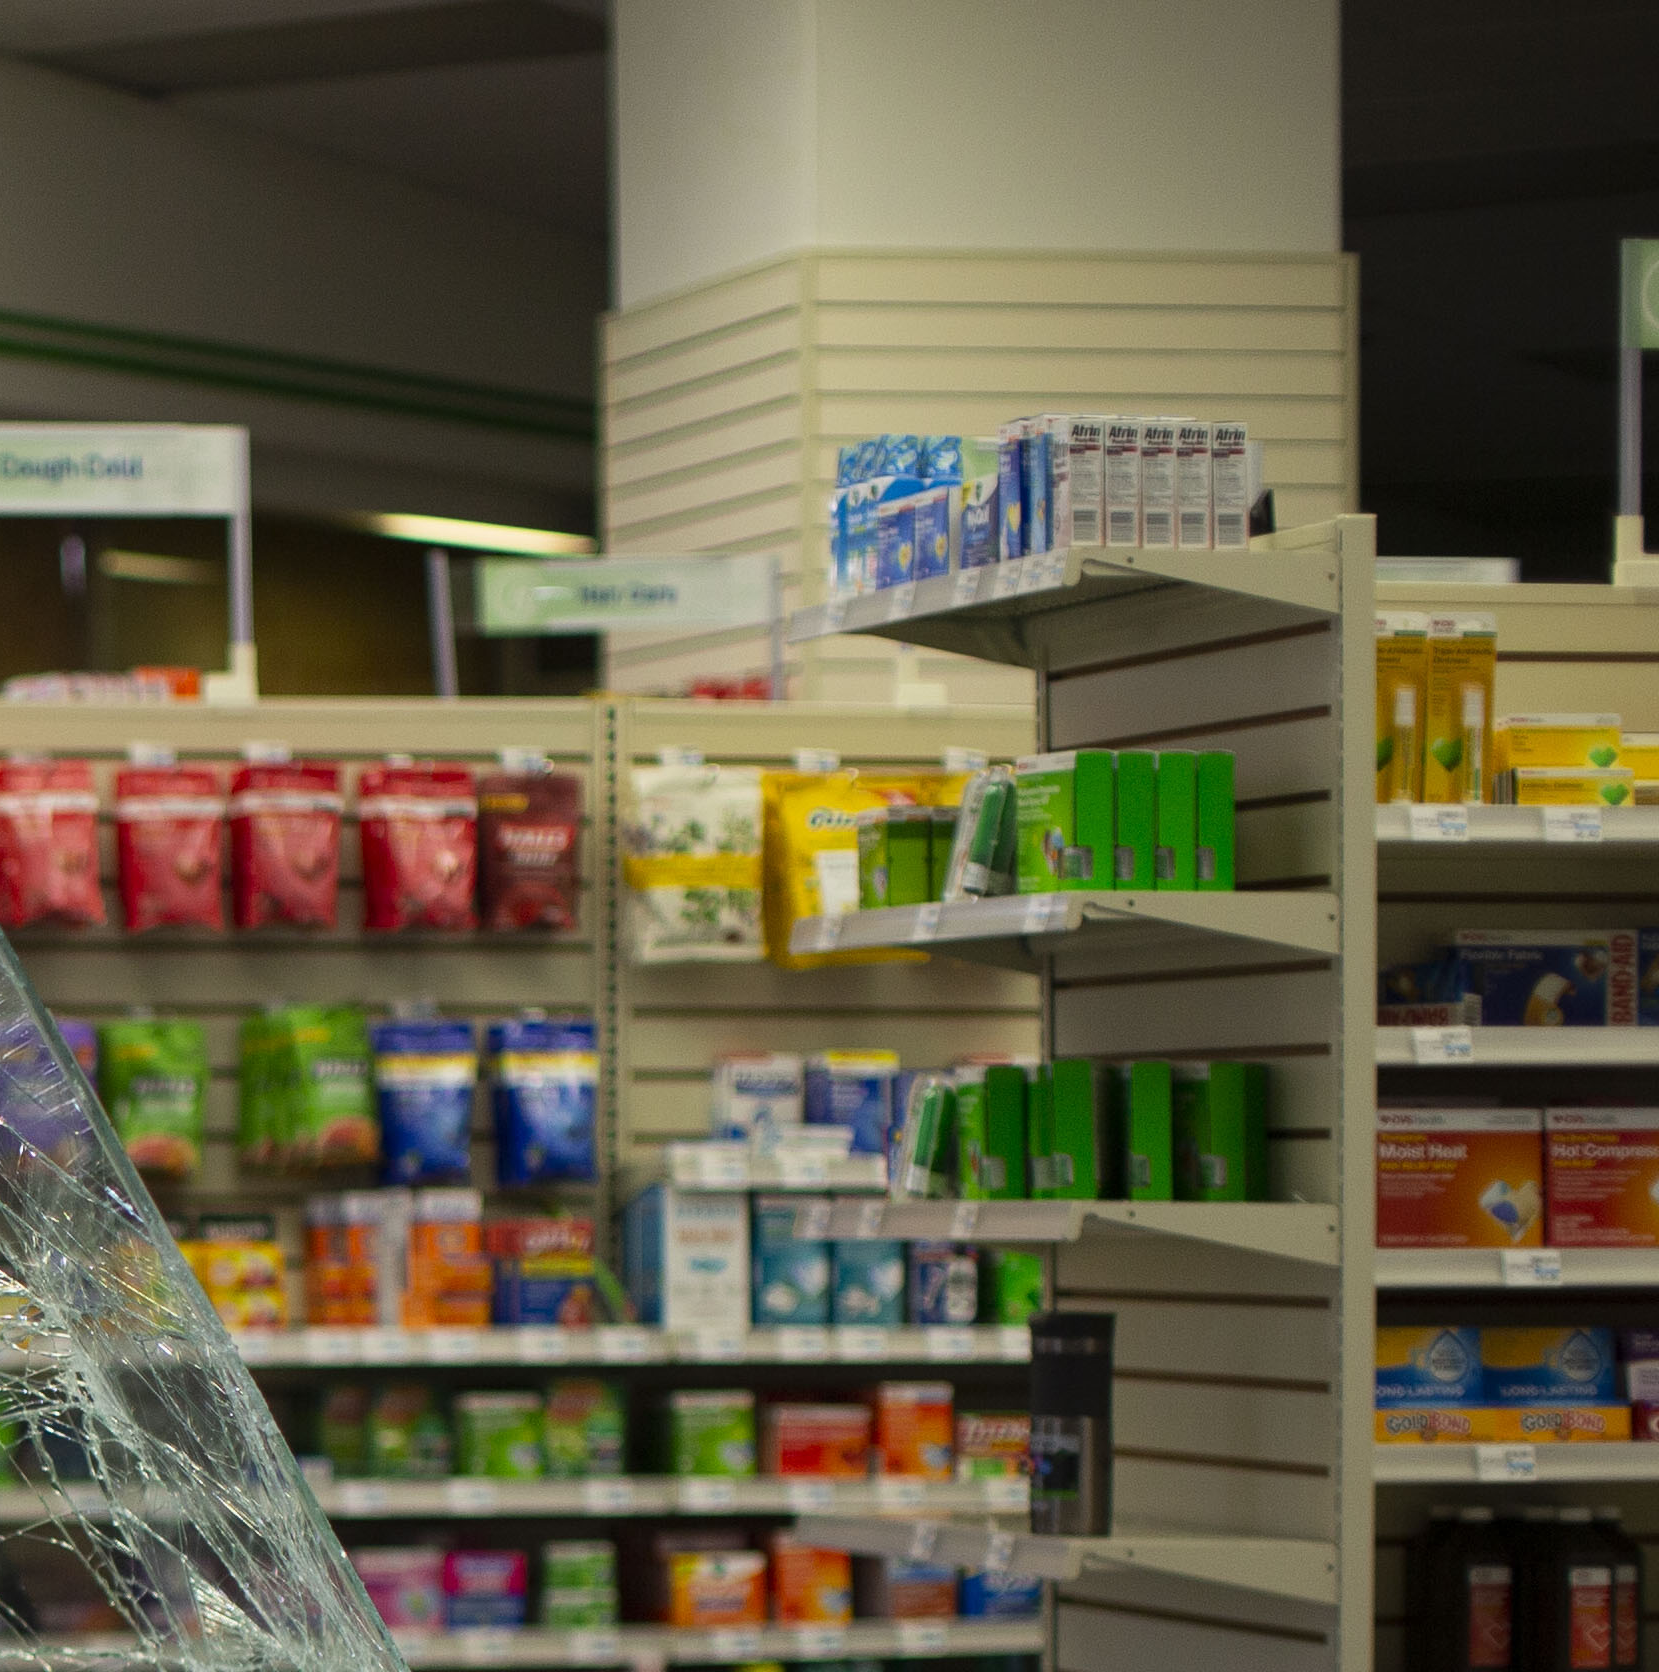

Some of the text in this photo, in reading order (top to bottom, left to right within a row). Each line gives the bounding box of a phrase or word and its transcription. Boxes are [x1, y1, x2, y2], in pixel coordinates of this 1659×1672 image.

[1071, 425, 1101, 437] Afrin
[1109, 426, 1138, 439] Afrin
[1145, 427, 1174, 440] Afrin
[1179, 427, 1209, 440] Afrin
[1215, 428, 1246, 441] Afrin
[1379, 1143, 1468, 1159] Moist Heat
[1552, 1143, 1581, 1157] Hot
[1386, 1412, 1471, 1434] GOLD BOND
[1521, 1411, 1606, 1434] GOLD BOND
